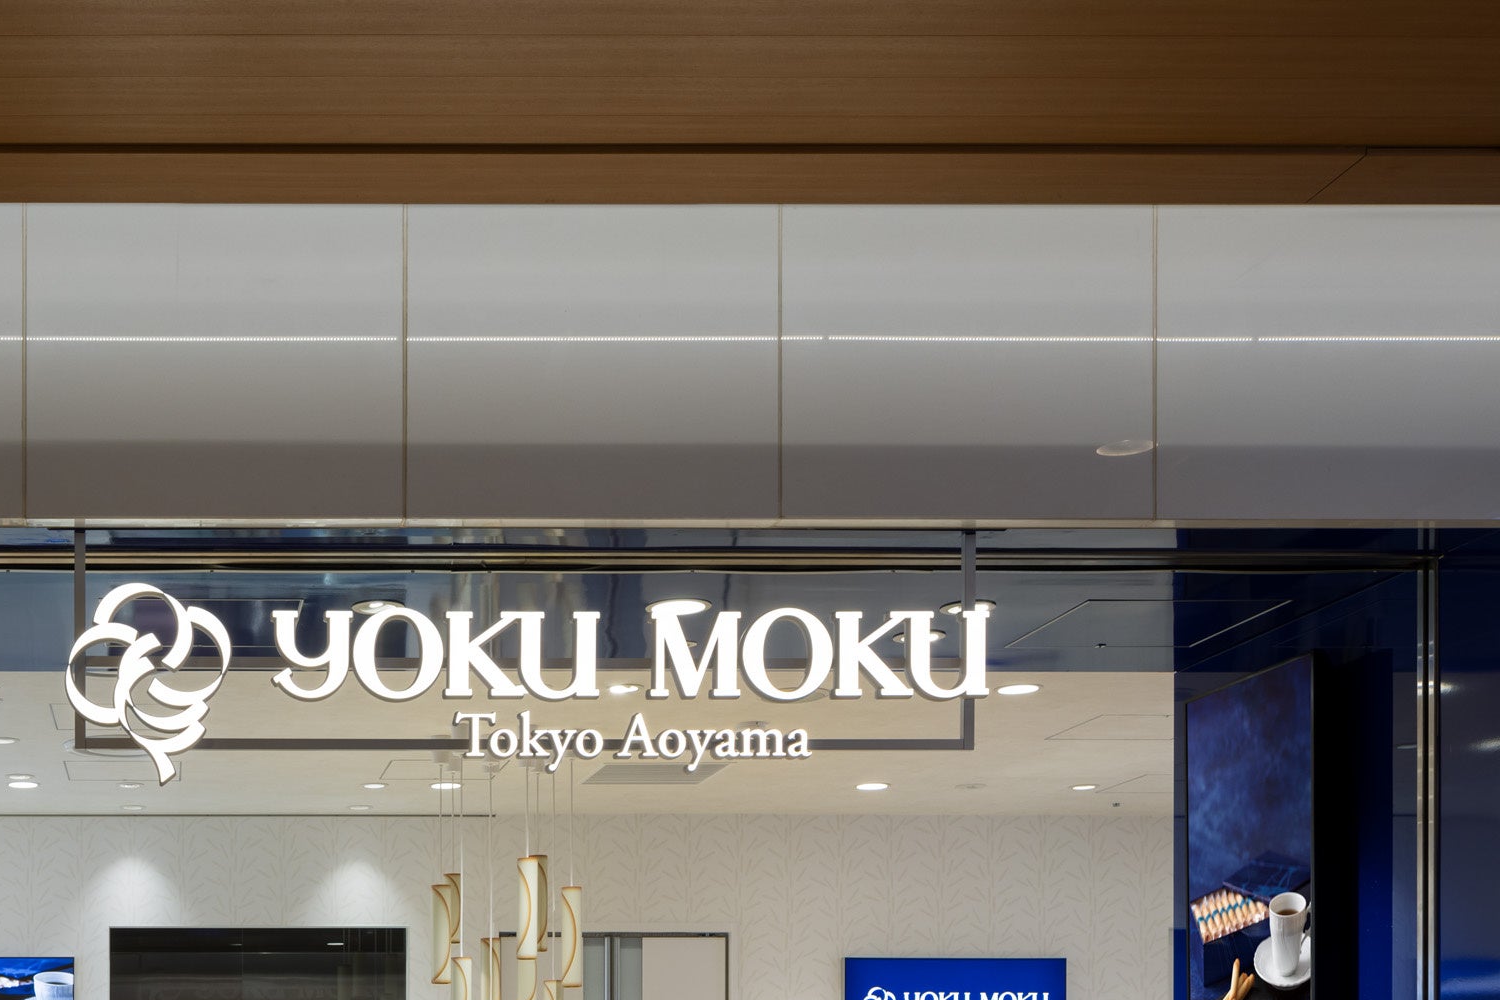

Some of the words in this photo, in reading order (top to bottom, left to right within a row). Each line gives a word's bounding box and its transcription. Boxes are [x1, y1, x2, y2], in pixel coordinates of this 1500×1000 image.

[271, 606, 601, 701] YOKU
[646, 607, 991, 702] MOKU
[453, 710, 604, 773] Tokyo
[613, 712, 813, 773] Aoyama
